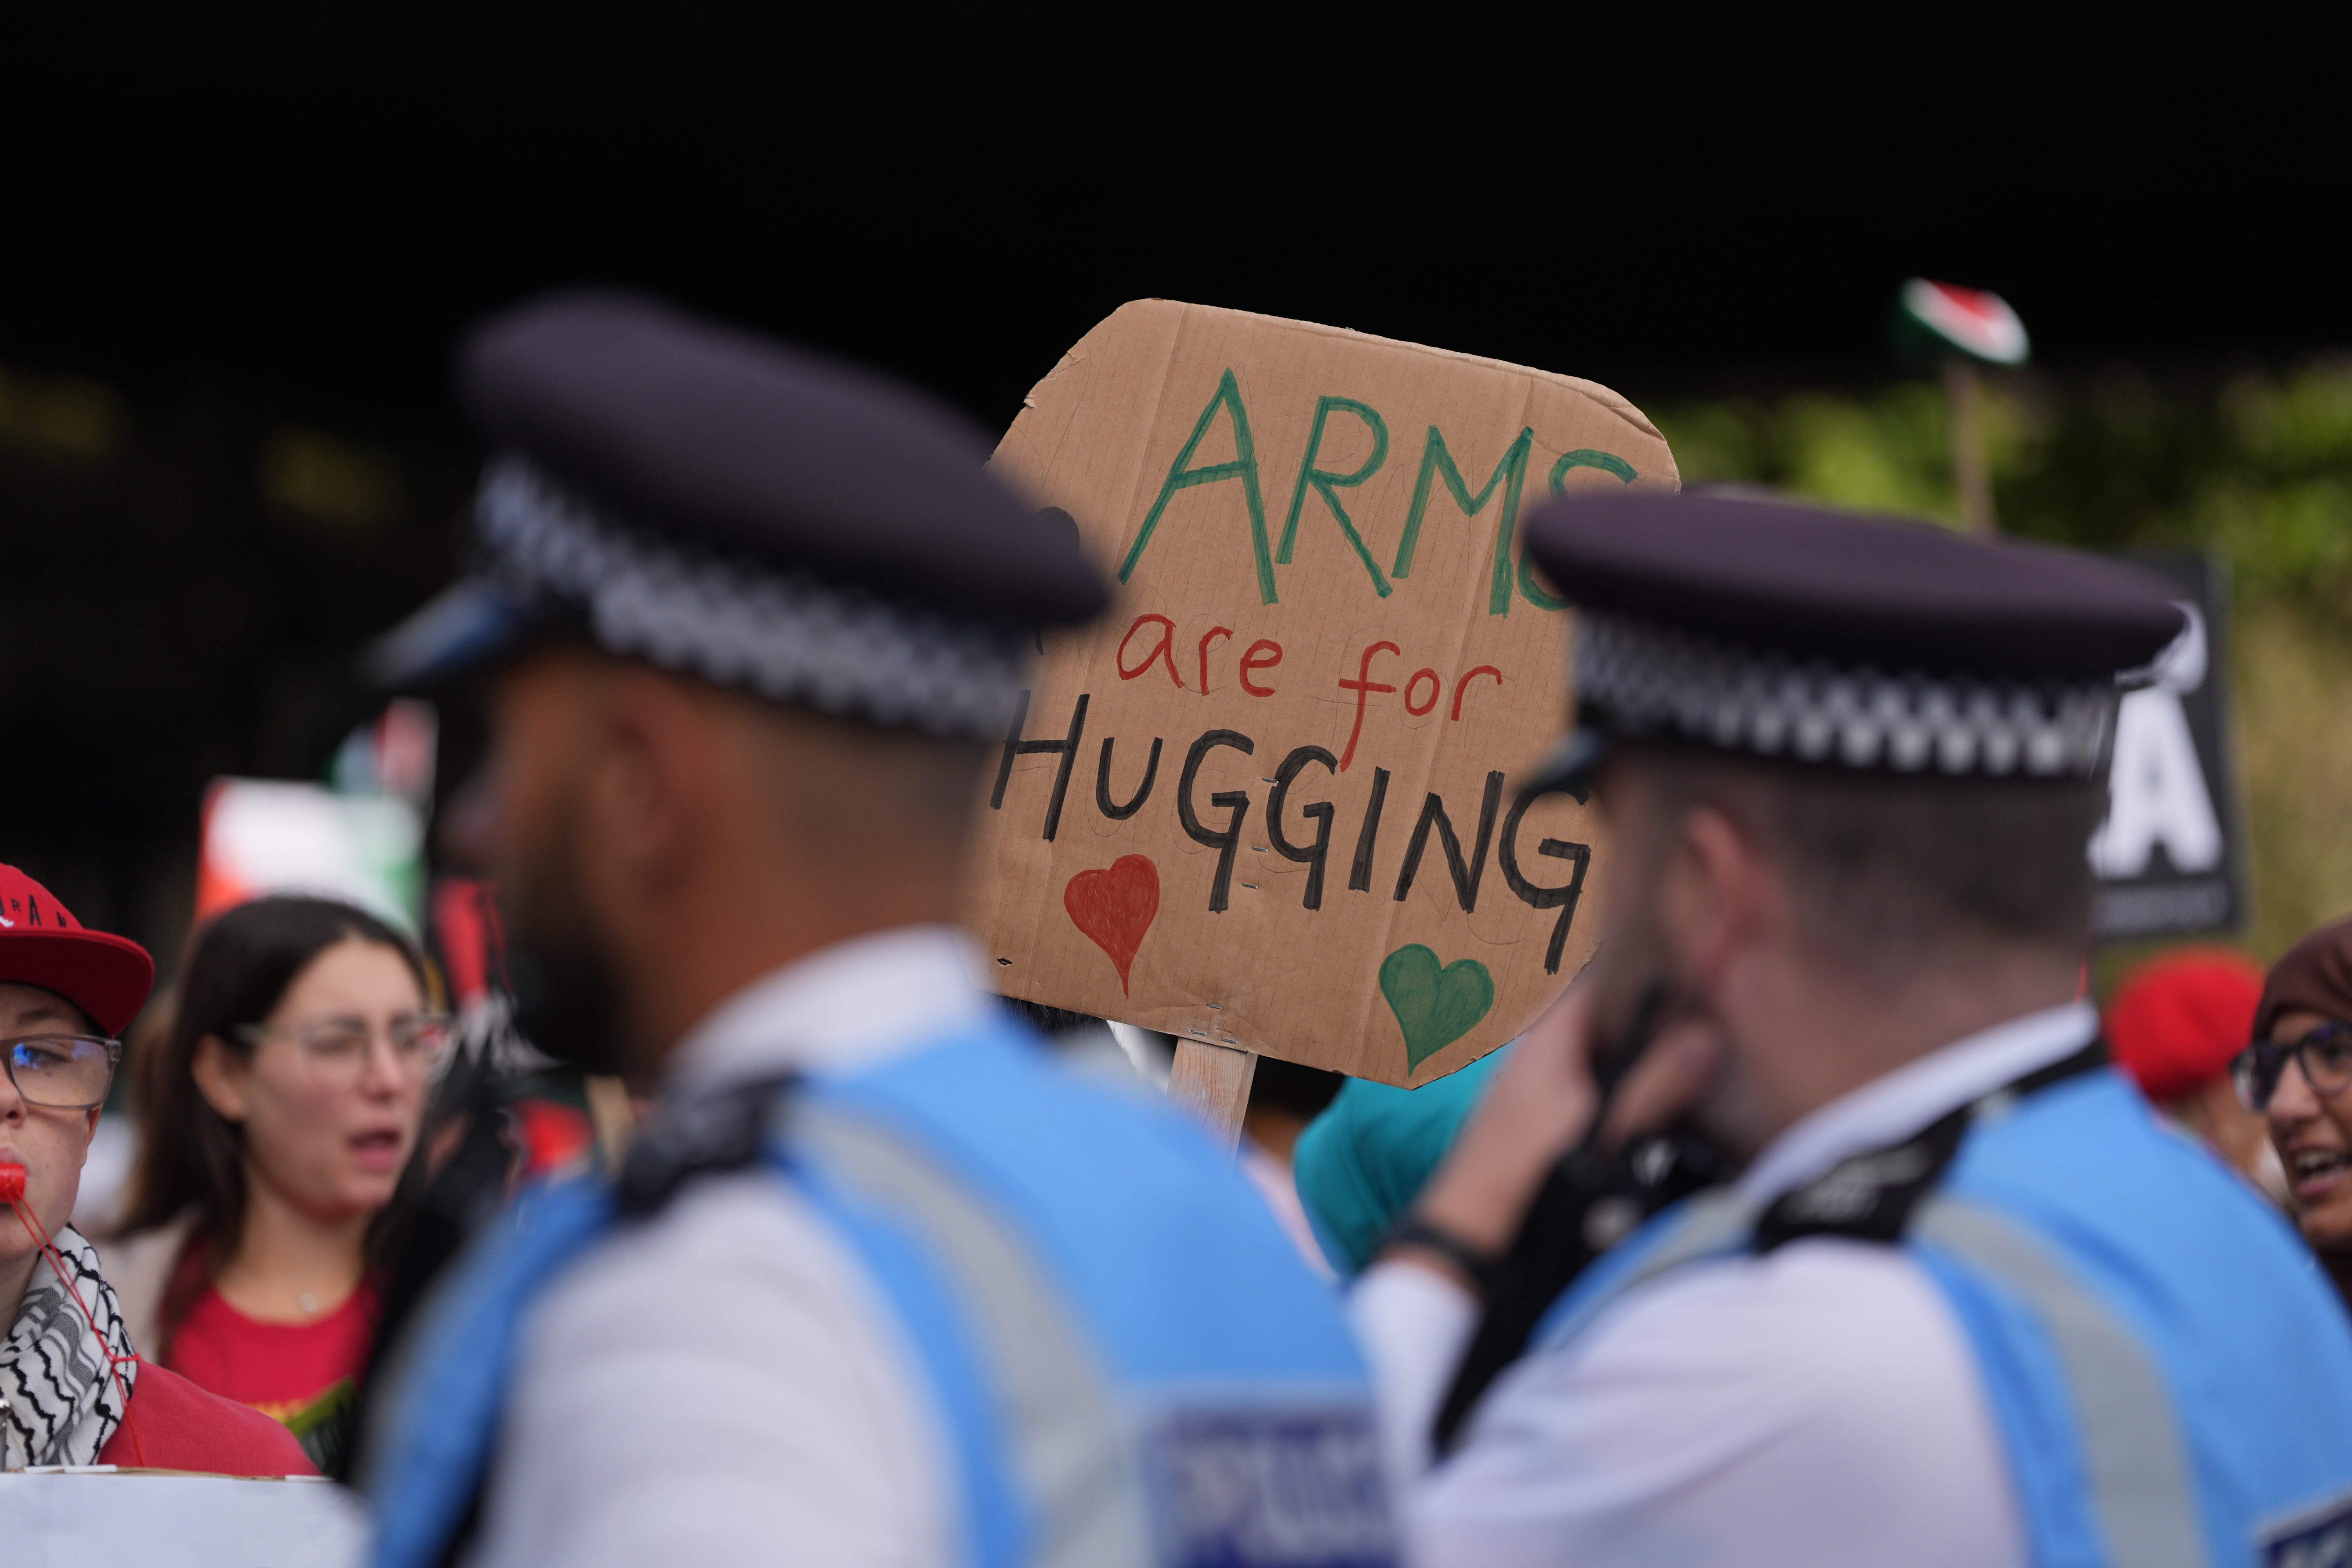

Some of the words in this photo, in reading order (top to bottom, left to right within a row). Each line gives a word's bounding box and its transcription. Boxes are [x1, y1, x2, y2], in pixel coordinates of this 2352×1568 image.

[1117, 613, 1283, 697] are
[1338, 640, 1501, 772] for
[990, 690, 1592, 975] HUGGING
